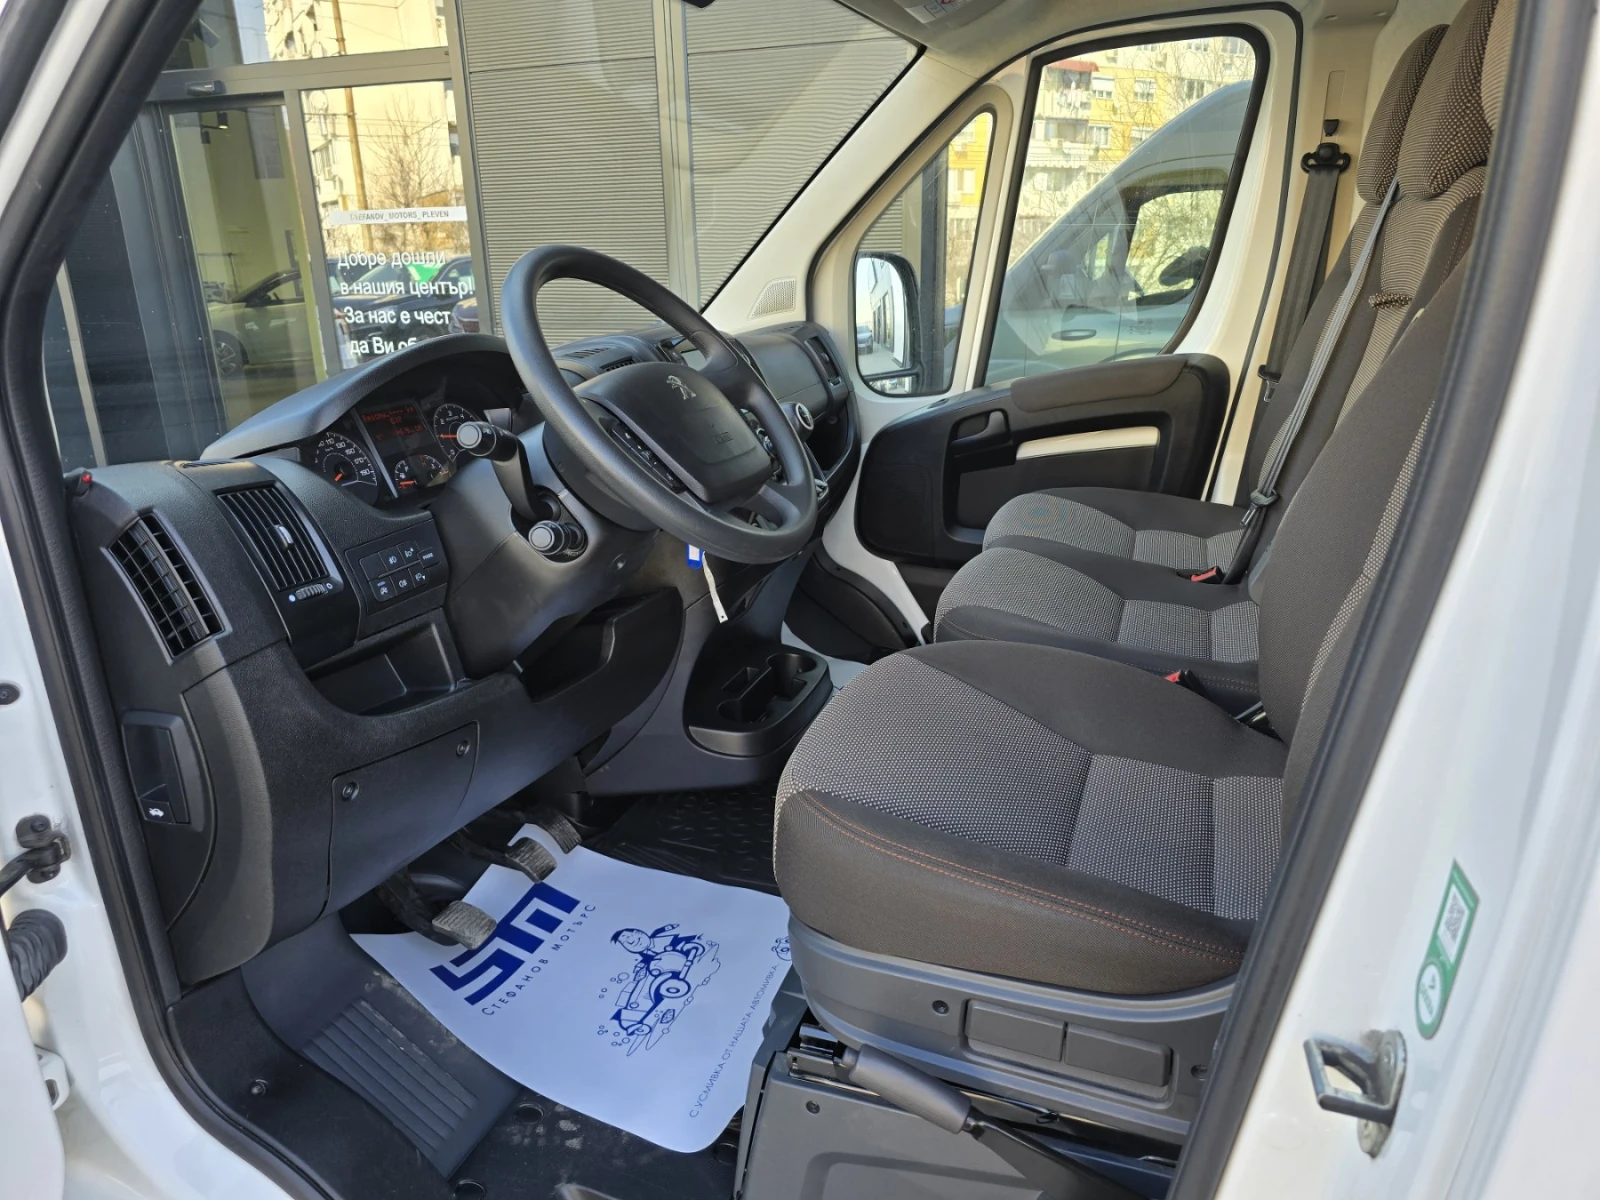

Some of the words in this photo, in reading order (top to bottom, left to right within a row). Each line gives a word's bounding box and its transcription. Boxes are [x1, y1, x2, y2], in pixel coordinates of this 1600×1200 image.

[338, 251, 387, 269] Добре
[391, 250, 446, 268] дошли
[341, 282, 349, 295] в
[352, 281, 405, 295] нашия
[409, 277, 474, 298] център!
[343, 306, 365, 324] За
[368, 310, 397, 324] нас
[400, 311, 411, 324] е
[414, 310, 450, 325] чест
[350, 340, 370, 356] да
[372, 337, 394, 355] Ви
[481, 959, 549, 1016] СТЕФАНОВ
[551, 904, 596, 951] МОТЪРС
[750, 963, 780, 1010] АВТОМИВКА
[729, 1011, 752, 1047] НАШАТА
[722, 1048, 733, 1061] ОТ
[694, 1062, 726, 1108] УСМИВКА
[689, 1109, 700, 1118] С
